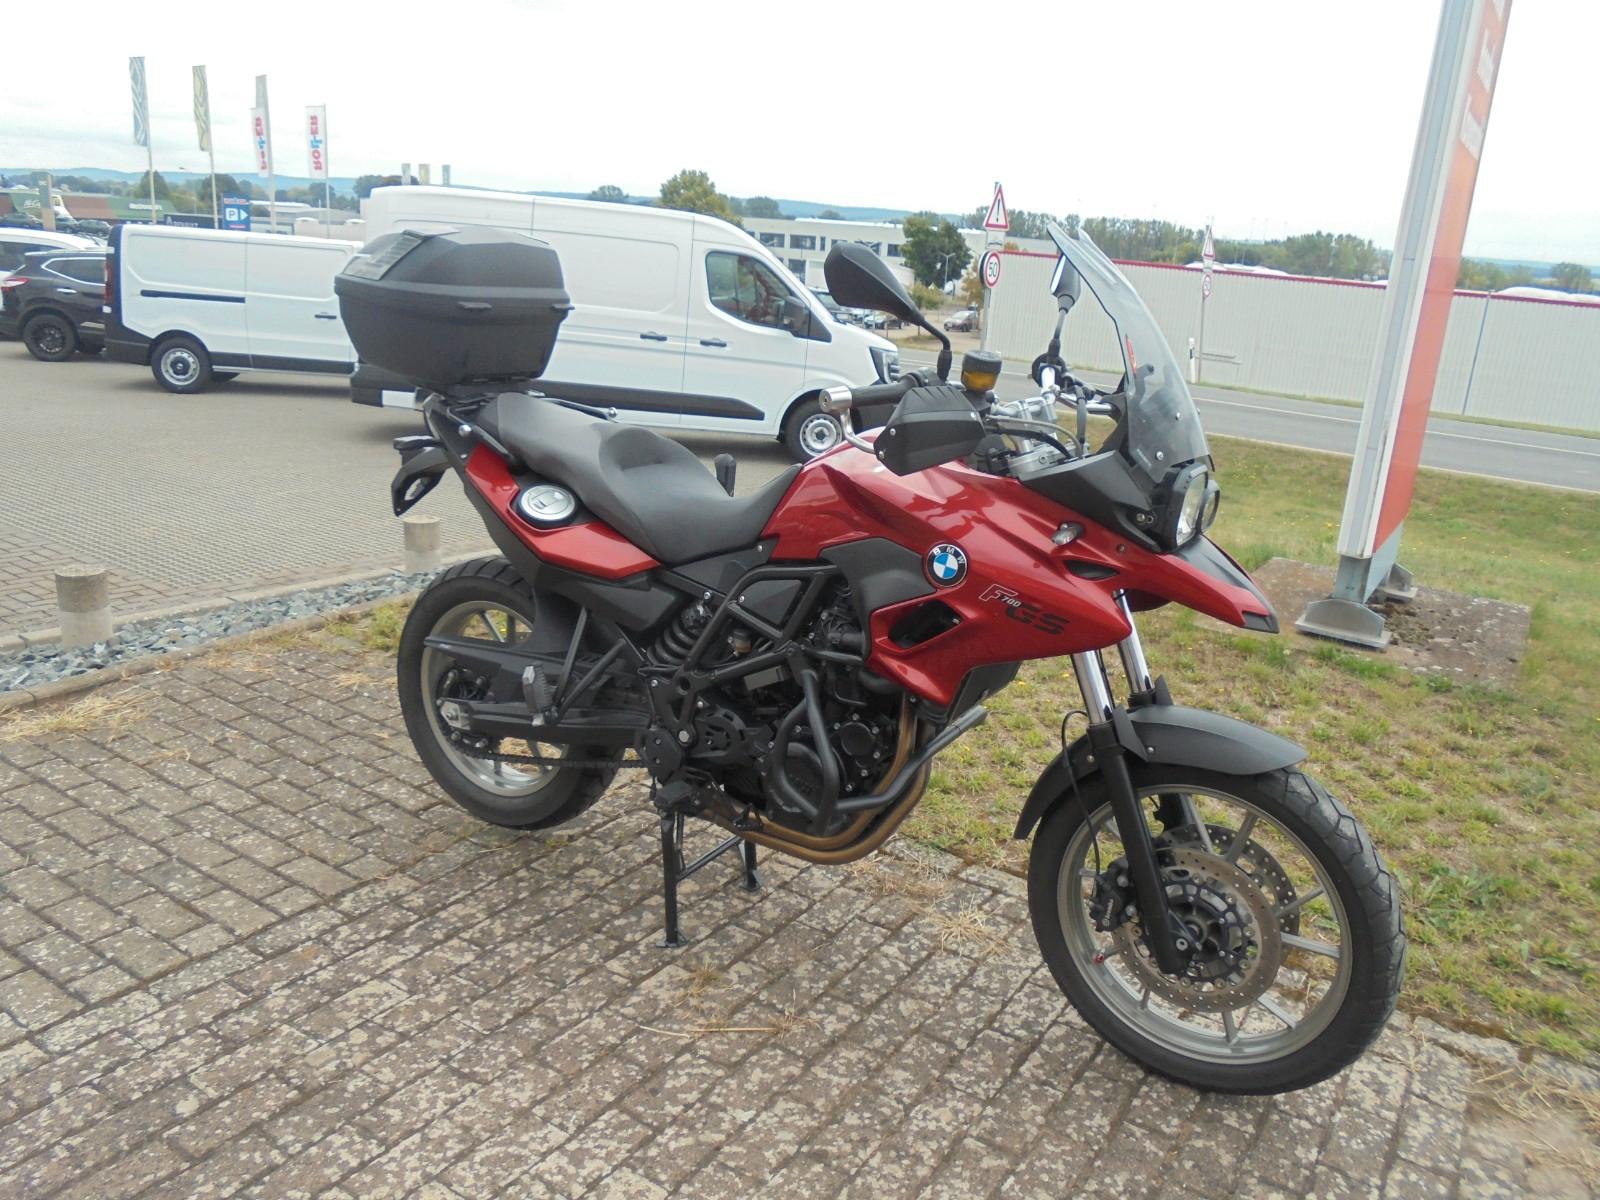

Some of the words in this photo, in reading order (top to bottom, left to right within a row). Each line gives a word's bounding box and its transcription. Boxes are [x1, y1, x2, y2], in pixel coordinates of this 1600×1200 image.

[988, 261, 998, 279] 50
[932, 545, 966, 565] BMW
[1001, 595, 1022, 608] 700
[1005, 603, 1071, 635] GS
